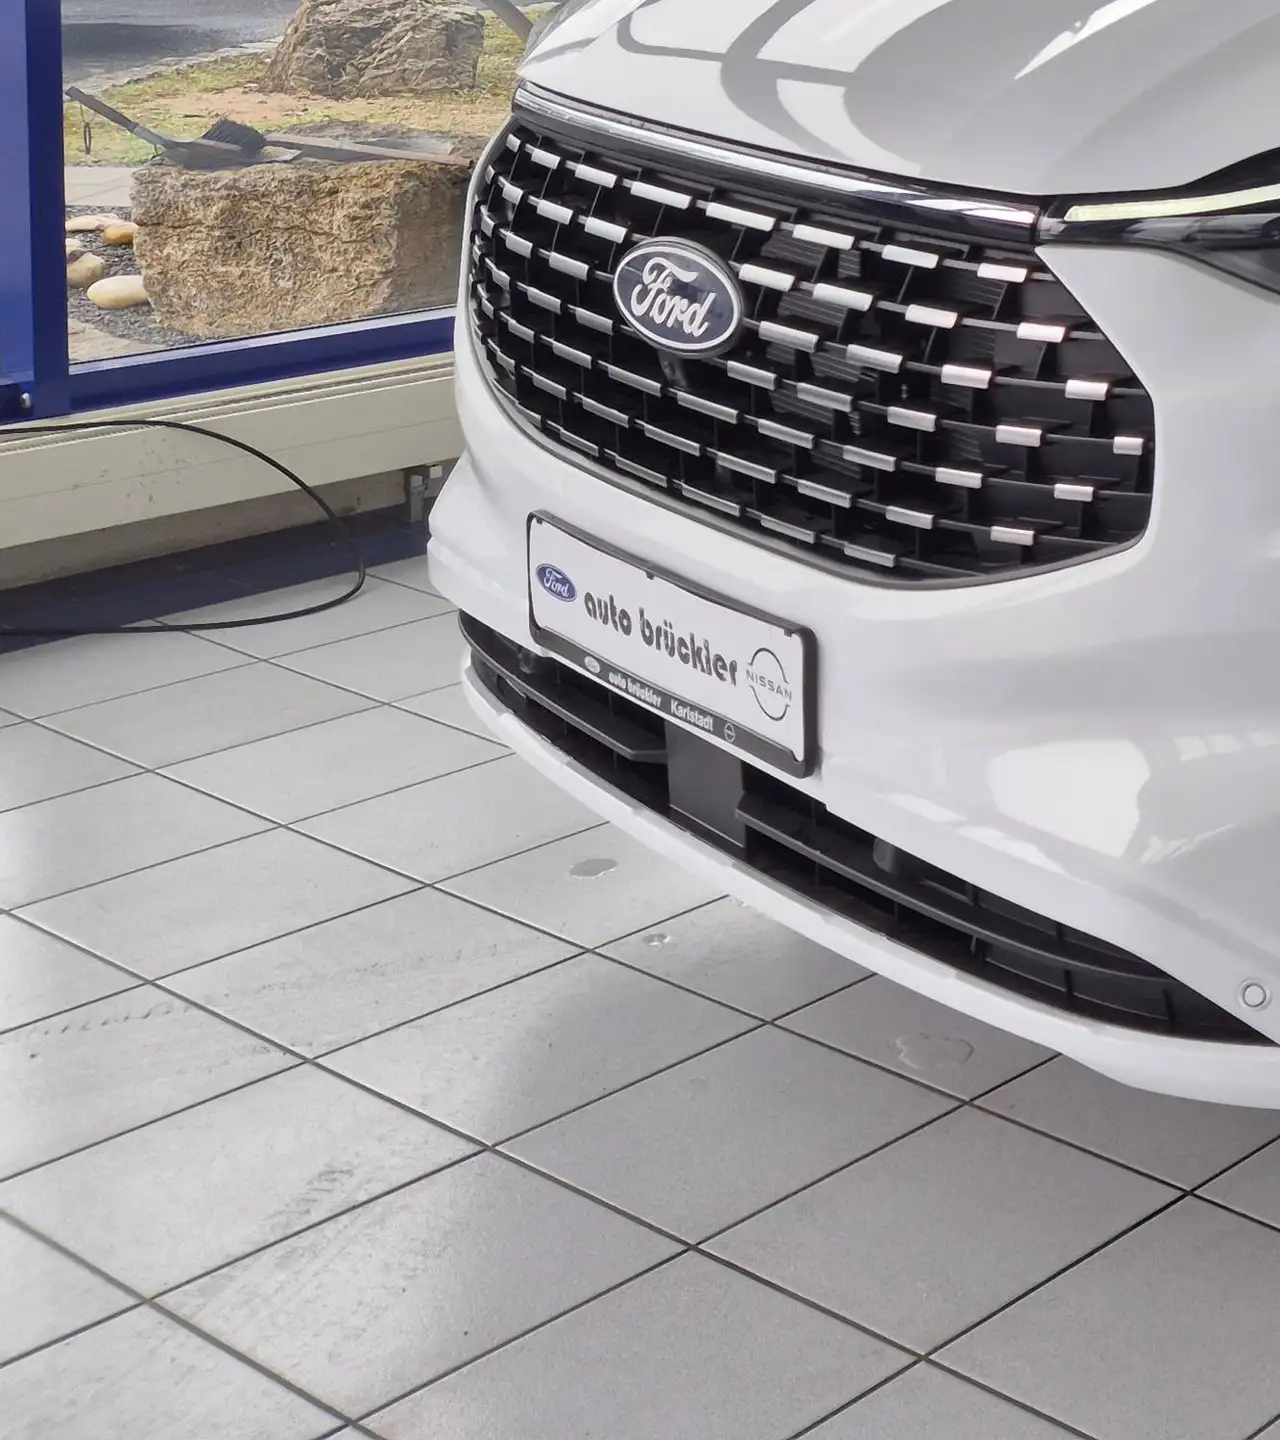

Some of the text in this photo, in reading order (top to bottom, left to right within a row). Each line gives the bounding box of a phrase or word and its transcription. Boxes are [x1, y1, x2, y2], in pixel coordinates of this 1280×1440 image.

[630, 256, 717, 338] Ford
[543, 567, 570, 598] Ford
[584, 592, 738, 686] auto brückler
[746, 670, 793, 701] NISSAN
[671, 699, 713, 732] Karlstadt
